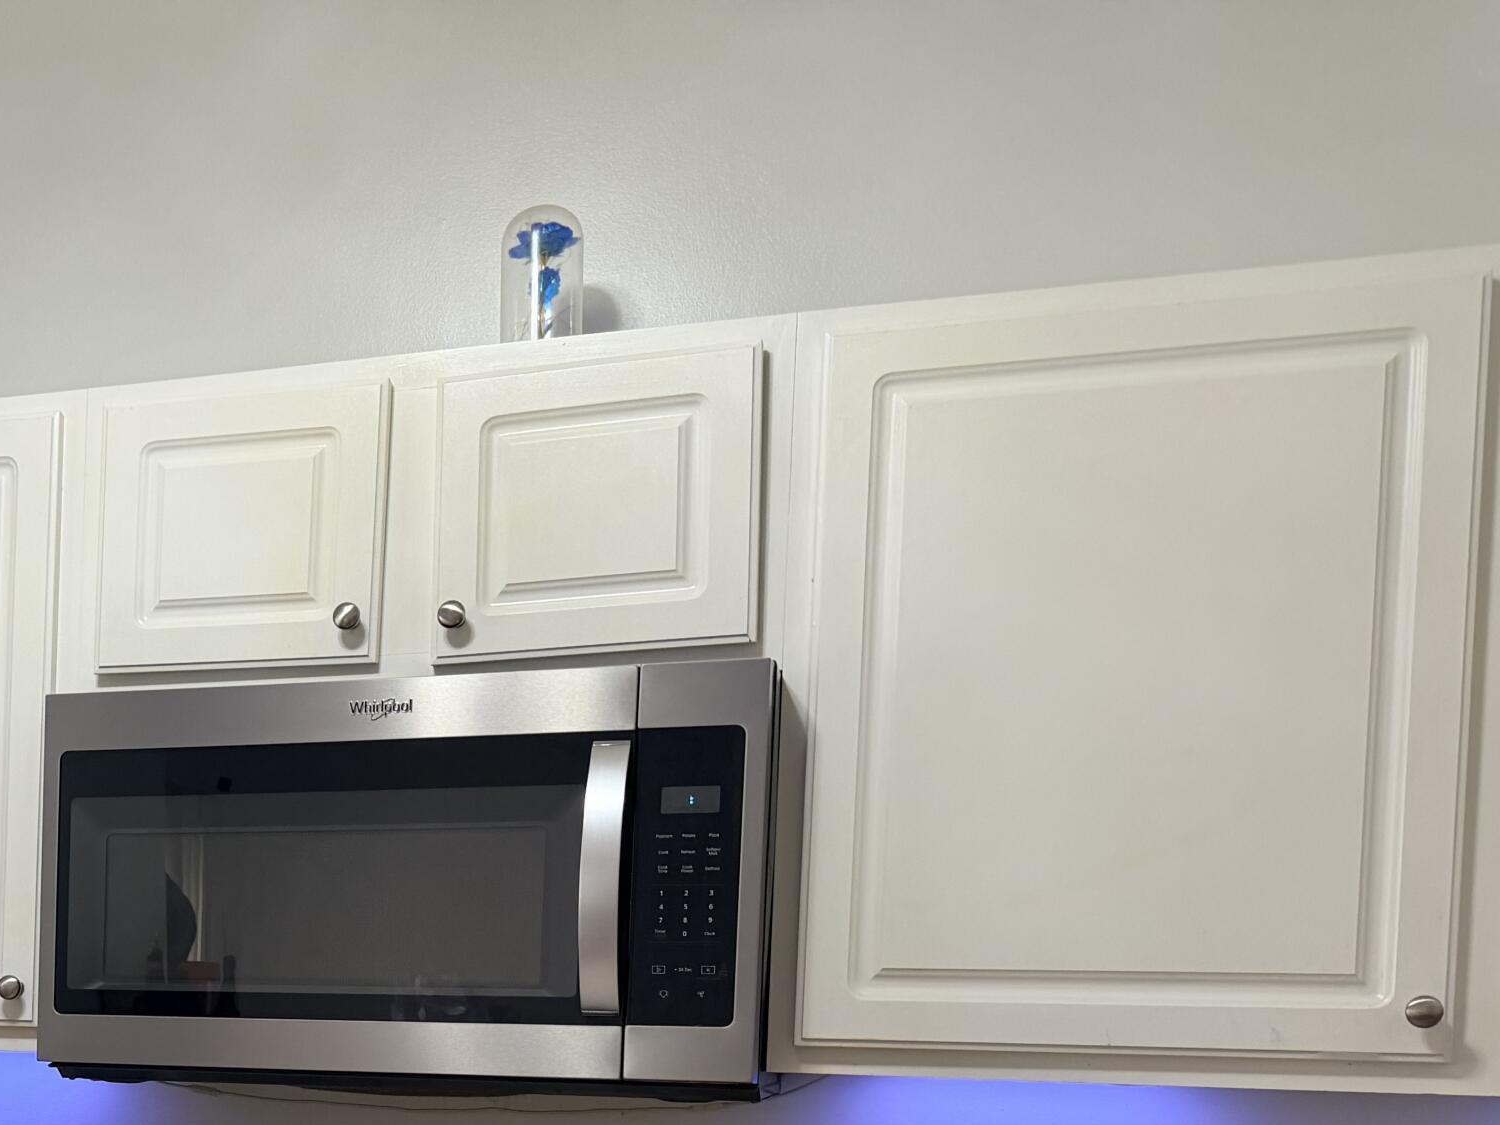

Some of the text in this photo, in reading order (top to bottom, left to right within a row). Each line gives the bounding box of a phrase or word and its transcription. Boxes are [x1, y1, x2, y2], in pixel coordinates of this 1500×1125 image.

[348, 698, 414, 721] Whirlpool
[683, 889, 689, 897] 2
[708, 889, 714, 897] 3
